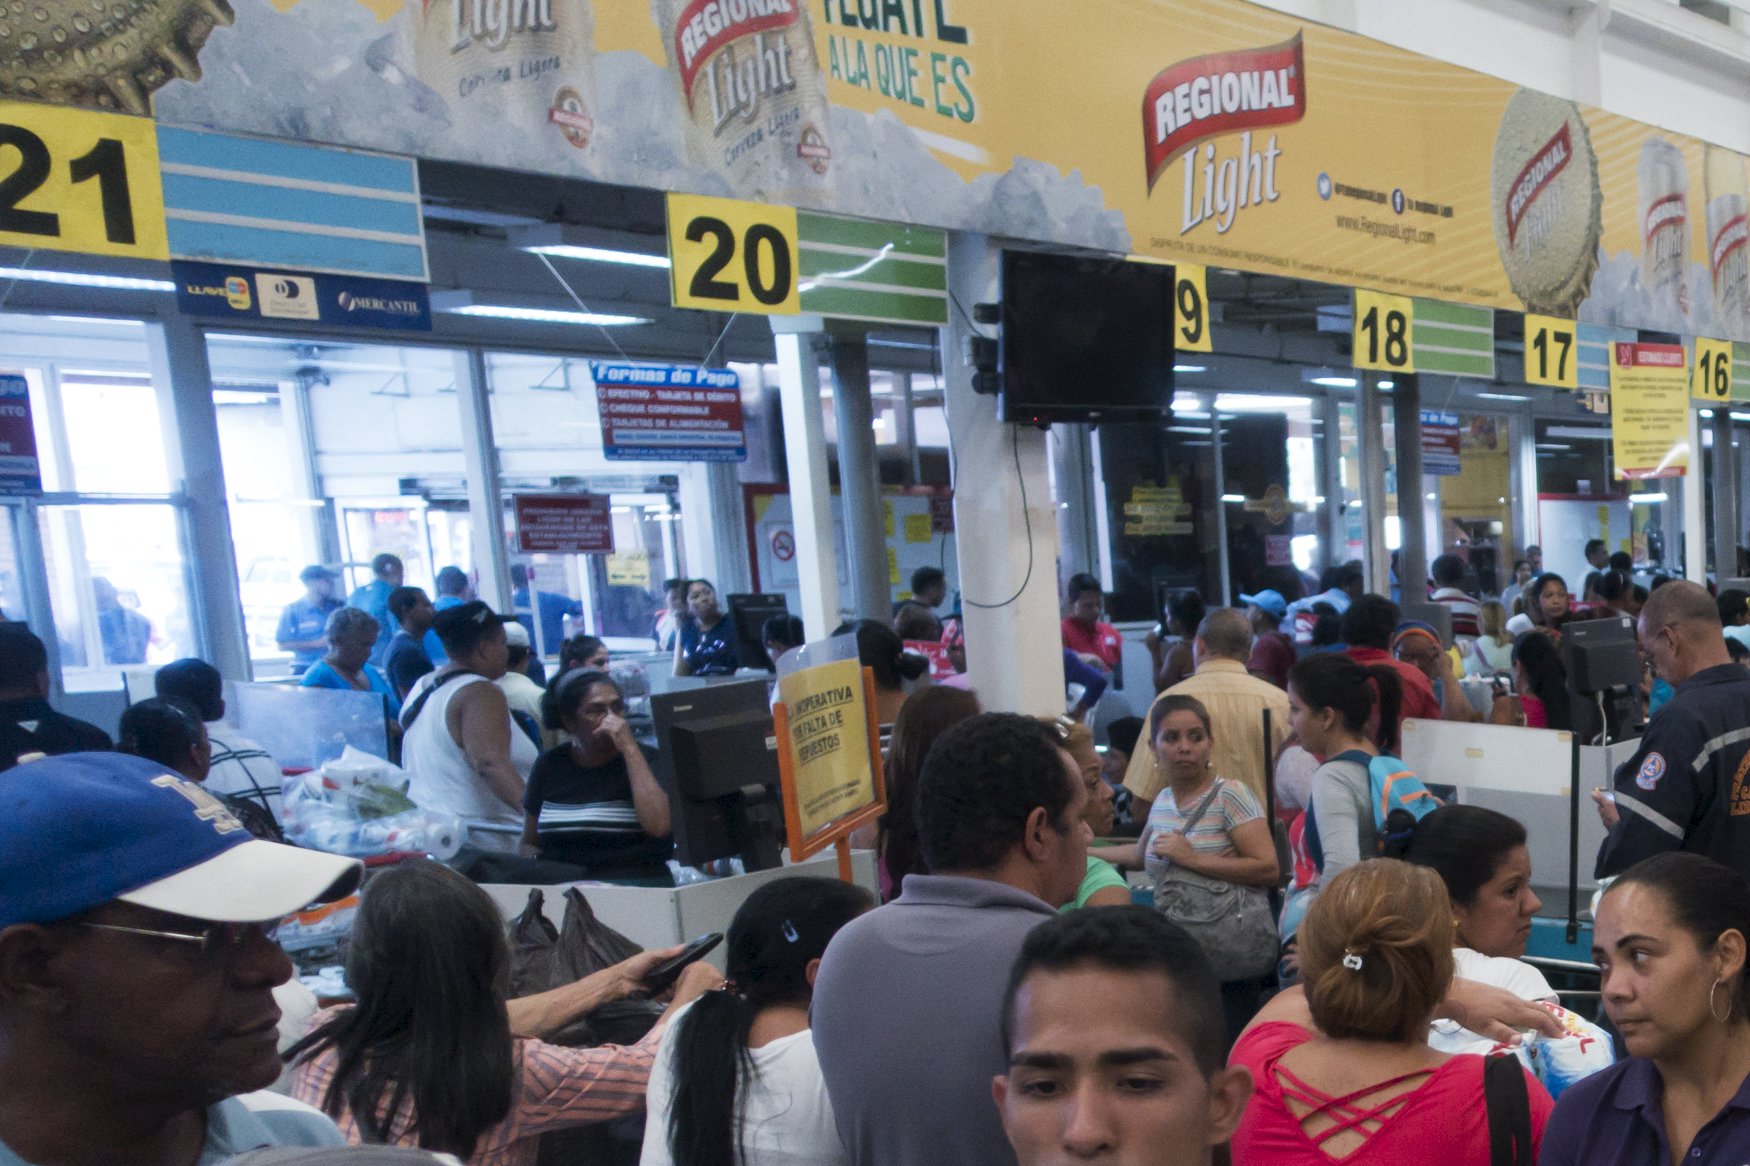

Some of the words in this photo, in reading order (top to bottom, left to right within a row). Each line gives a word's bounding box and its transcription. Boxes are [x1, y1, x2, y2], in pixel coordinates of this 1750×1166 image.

[706, 33, 794, 132] Light
[829, 34, 841, 80] A
[843, 37, 871, 91] LA
[874, 42, 925, 108] QUE
[930, 51, 975, 123] ES
[1155, 68, 1296, 146] REGIONAL
[0, 122, 136, 245] 21
[1179, 130, 1283, 237] Light
[1509, 140, 1569, 226] REGIONAL
[684, 215, 793, 306] 20
[353, 297, 420, 314] MERCANTIL
[1359, 304, 1408, 368] 18
[597, 364, 667, 383] Formas
[670, 367, 692, 384] de
[695, 368, 737, 388] Pago
[1532, 326, 1571, 382] 17
[1699, 349, 1730, 398] 16
[829, 710, 844, 725] DE
